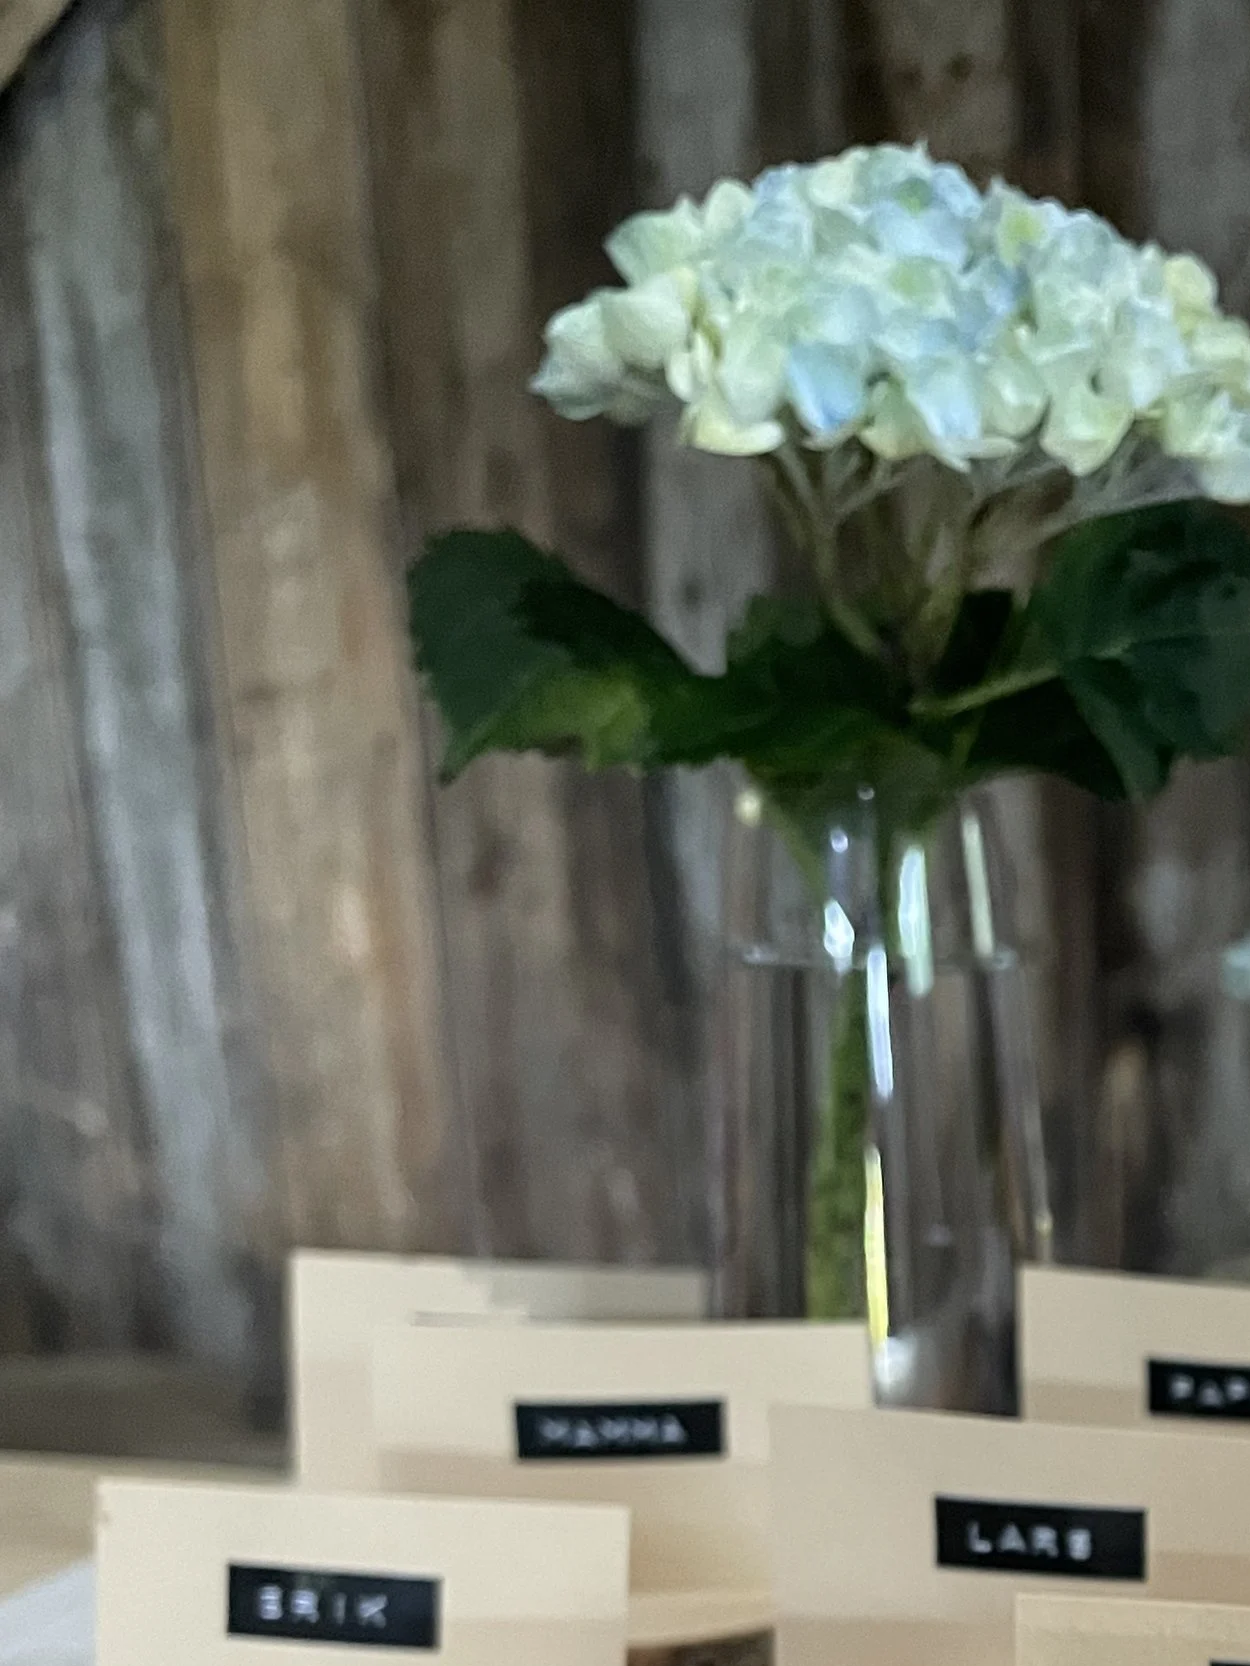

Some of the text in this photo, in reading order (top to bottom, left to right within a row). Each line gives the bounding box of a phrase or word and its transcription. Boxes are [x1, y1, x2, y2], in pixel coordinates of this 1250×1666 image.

[538, 1415, 688, 1448] MAMMA
[967, 1521, 1092, 1561] LARS
[258, 1584, 387, 1628] ERIK
